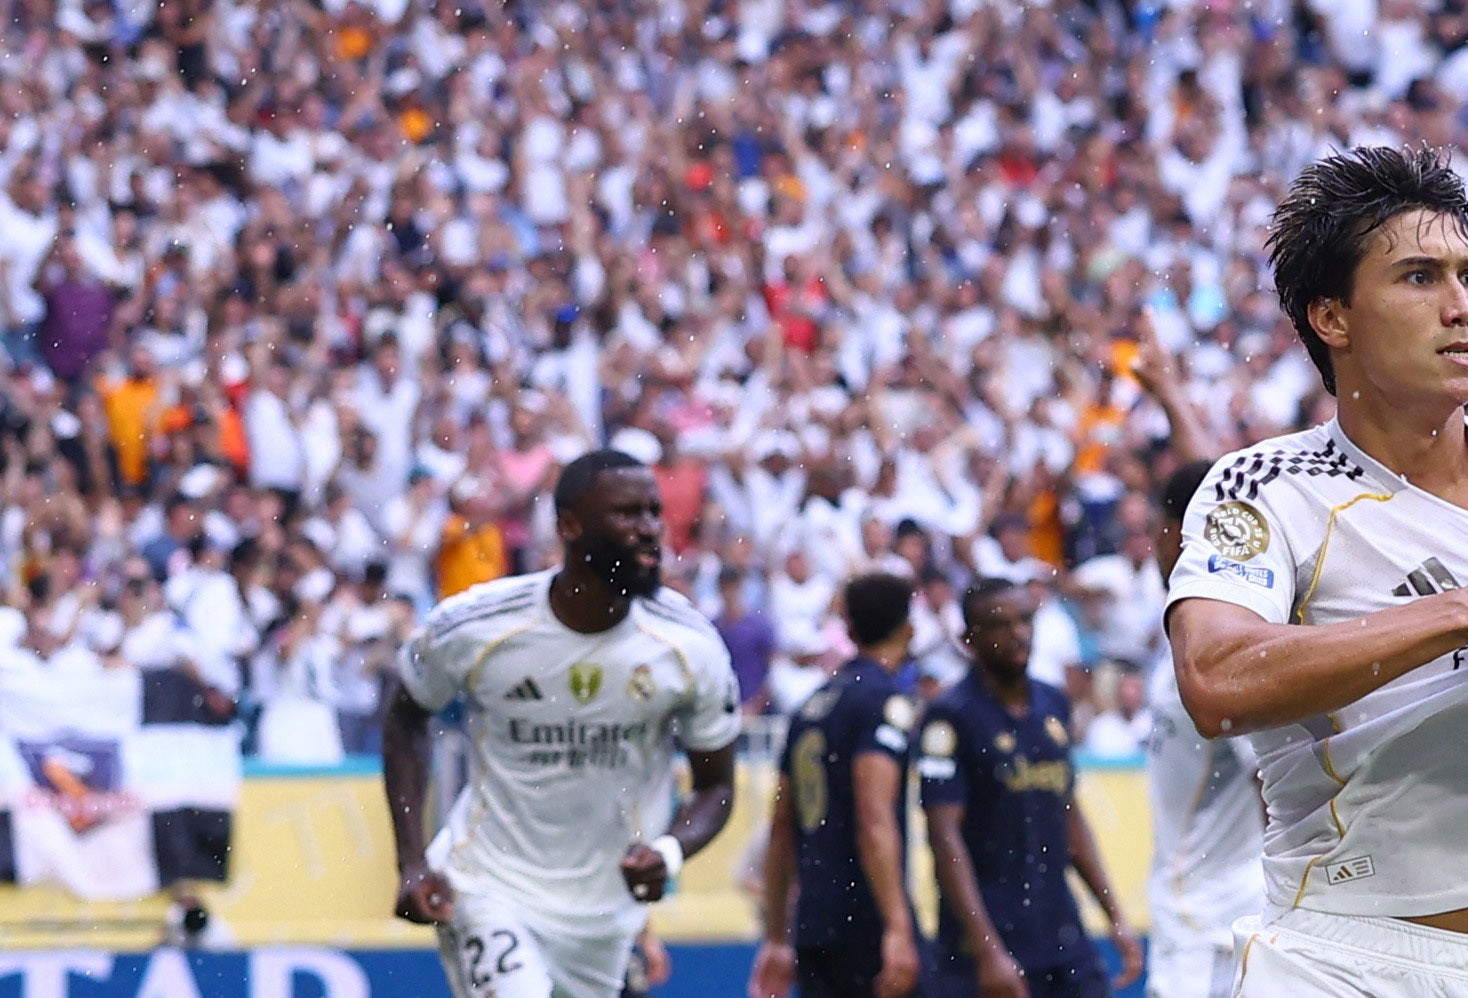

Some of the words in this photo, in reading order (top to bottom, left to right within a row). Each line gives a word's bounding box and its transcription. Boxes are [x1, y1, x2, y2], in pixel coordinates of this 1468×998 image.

[1241, 510, 1259, 525] CUP
[1222, 544, 1250, 556] FIFA
[465, 929, 523, 988] 22
